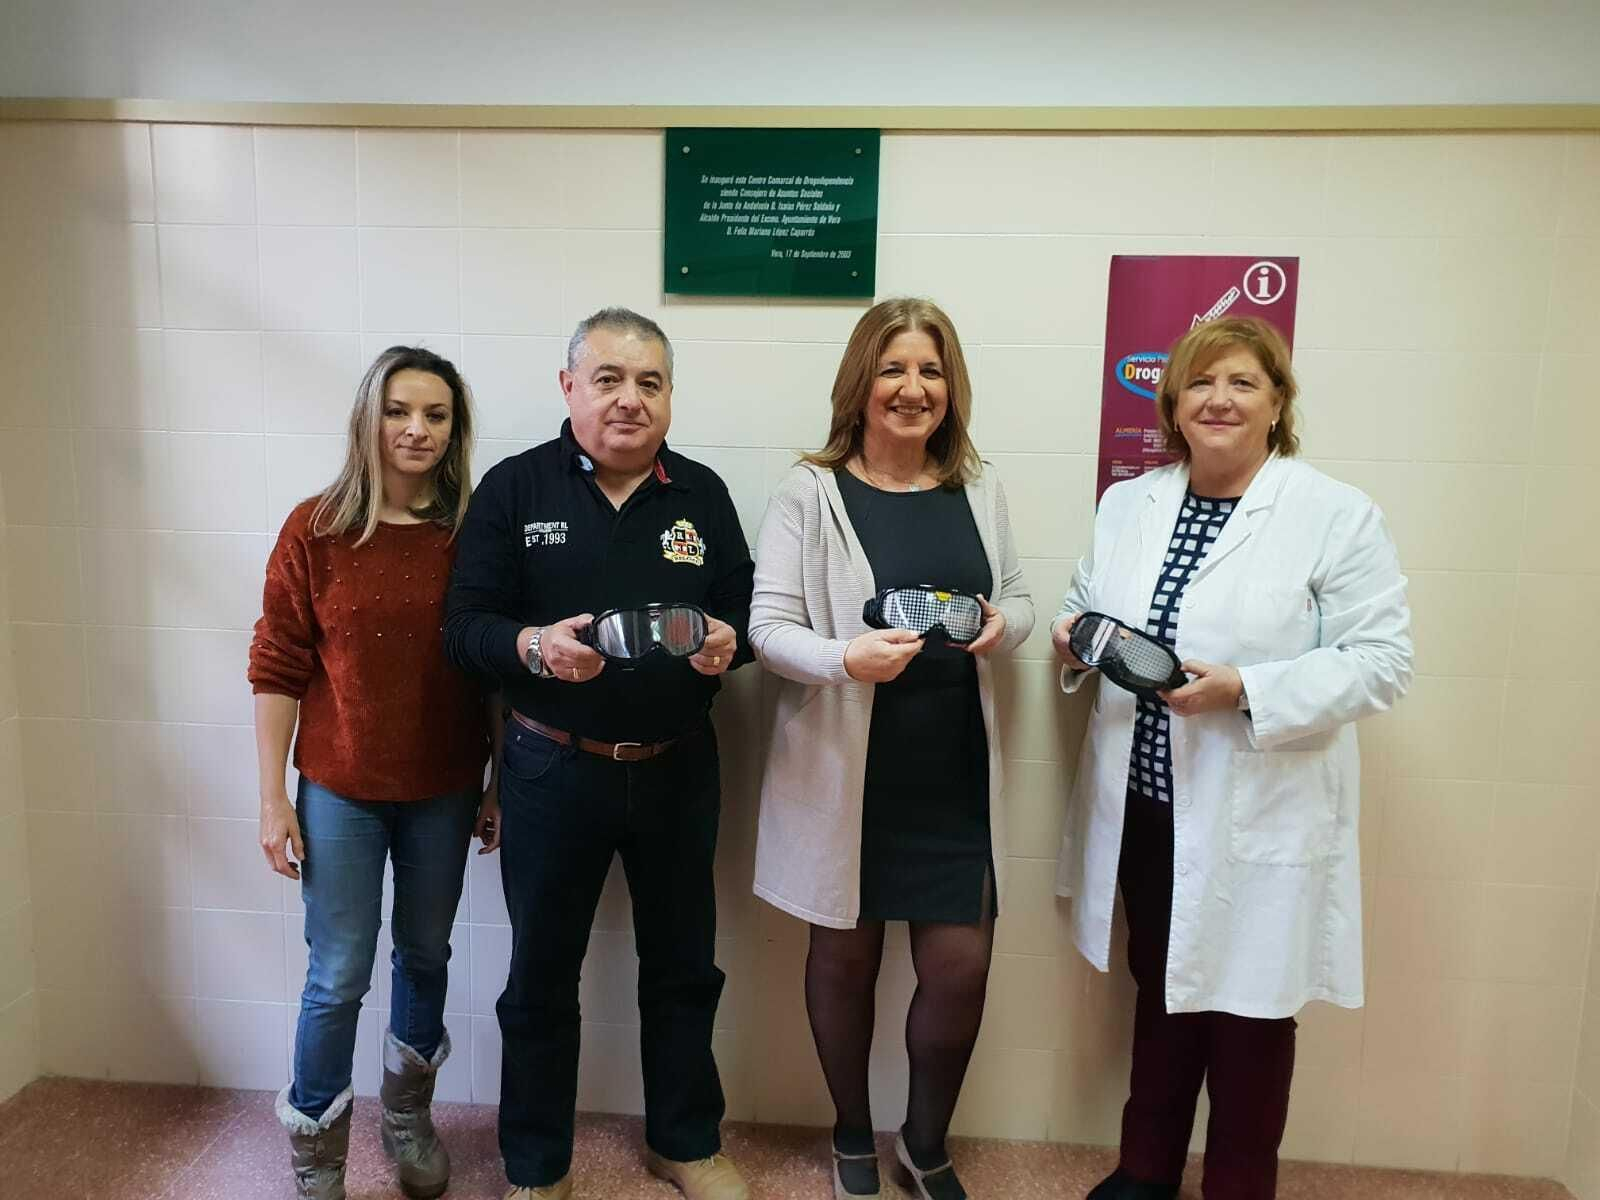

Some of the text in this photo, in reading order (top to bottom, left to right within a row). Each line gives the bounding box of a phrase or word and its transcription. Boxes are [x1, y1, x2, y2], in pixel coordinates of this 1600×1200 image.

[767, 175, 794, 185] Comarcal
[795, 175, 802, 185] de
[768, 188, 776, 197] de
[800, 188, 824, 198] Sociales
[718, 201, 734, 210] Junta
[735, 201, 742, 210] de
[750, 214, 760, 223] del
[819, 215, 827, 224] de
[828, 215, 841, 224] Vera
[793, 249, 800, 258] de
[829, 250, 837, 258] de
